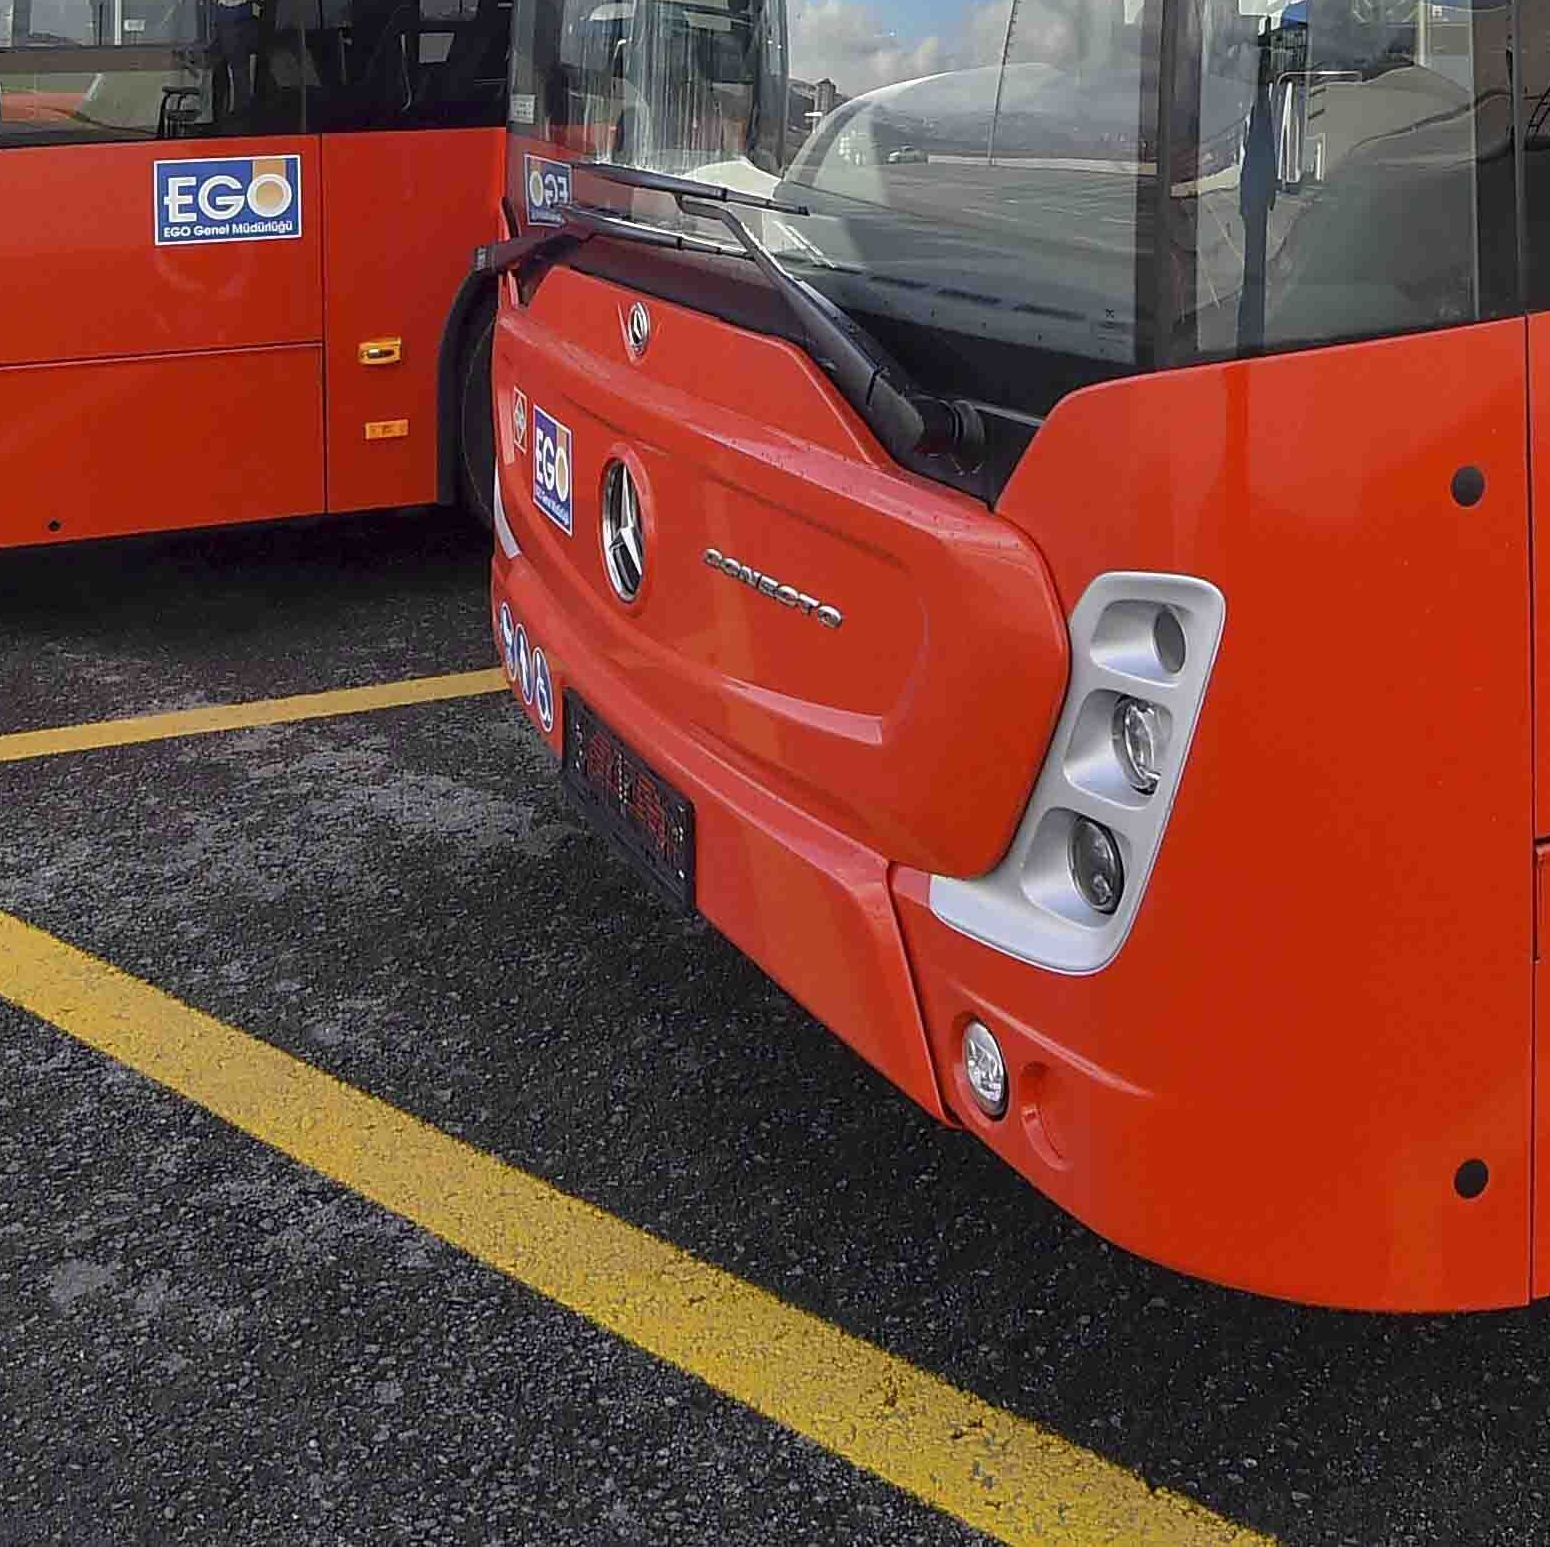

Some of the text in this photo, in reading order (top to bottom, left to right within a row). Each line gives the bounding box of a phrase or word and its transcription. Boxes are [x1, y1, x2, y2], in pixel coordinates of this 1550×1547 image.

[164, 174, 293, 223] EGO
[163, 227, 191, 238] EGO
[194, 224, 229, 237] Genel
[535, 426, 569, 502] EGO
